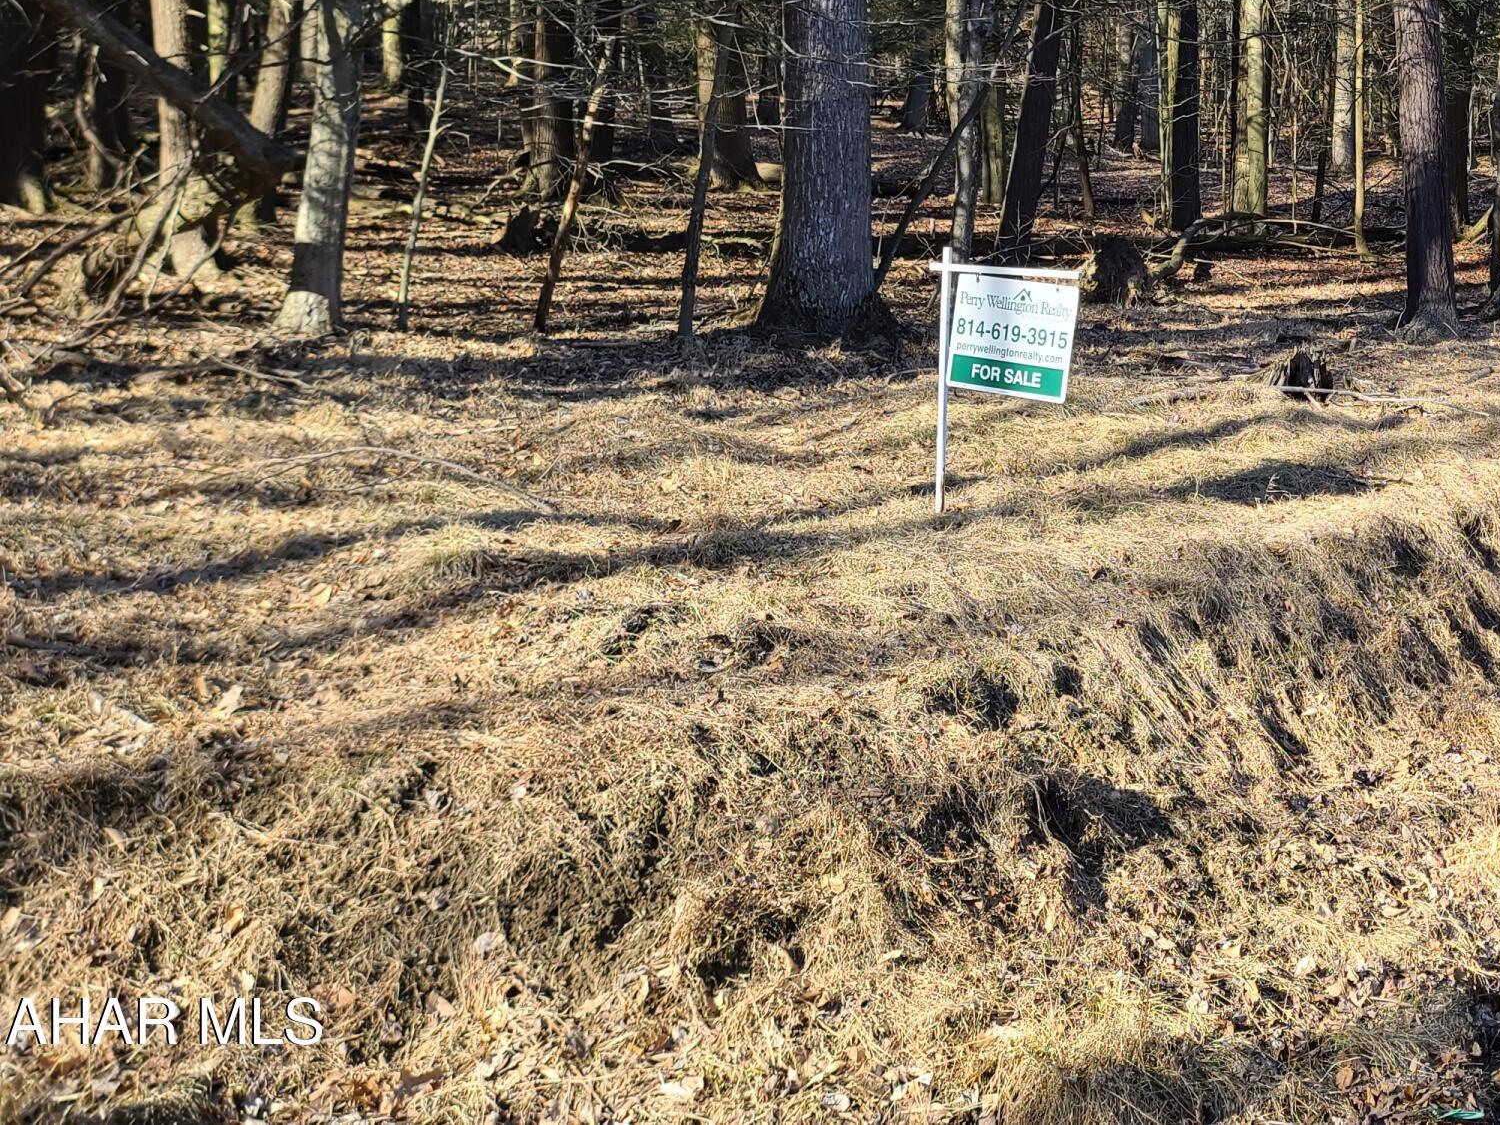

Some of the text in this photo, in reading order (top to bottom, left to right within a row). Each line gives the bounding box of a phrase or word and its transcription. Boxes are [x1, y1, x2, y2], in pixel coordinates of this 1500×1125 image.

[960, 291, 1073, 320] Perry Wellington Realty
[956, 317, 1068, 349] 814-619-3915
[956, 341, 1063, 364] perrywellingtonrealty.com
[971, 363, 1042, 388] FOR SALE
